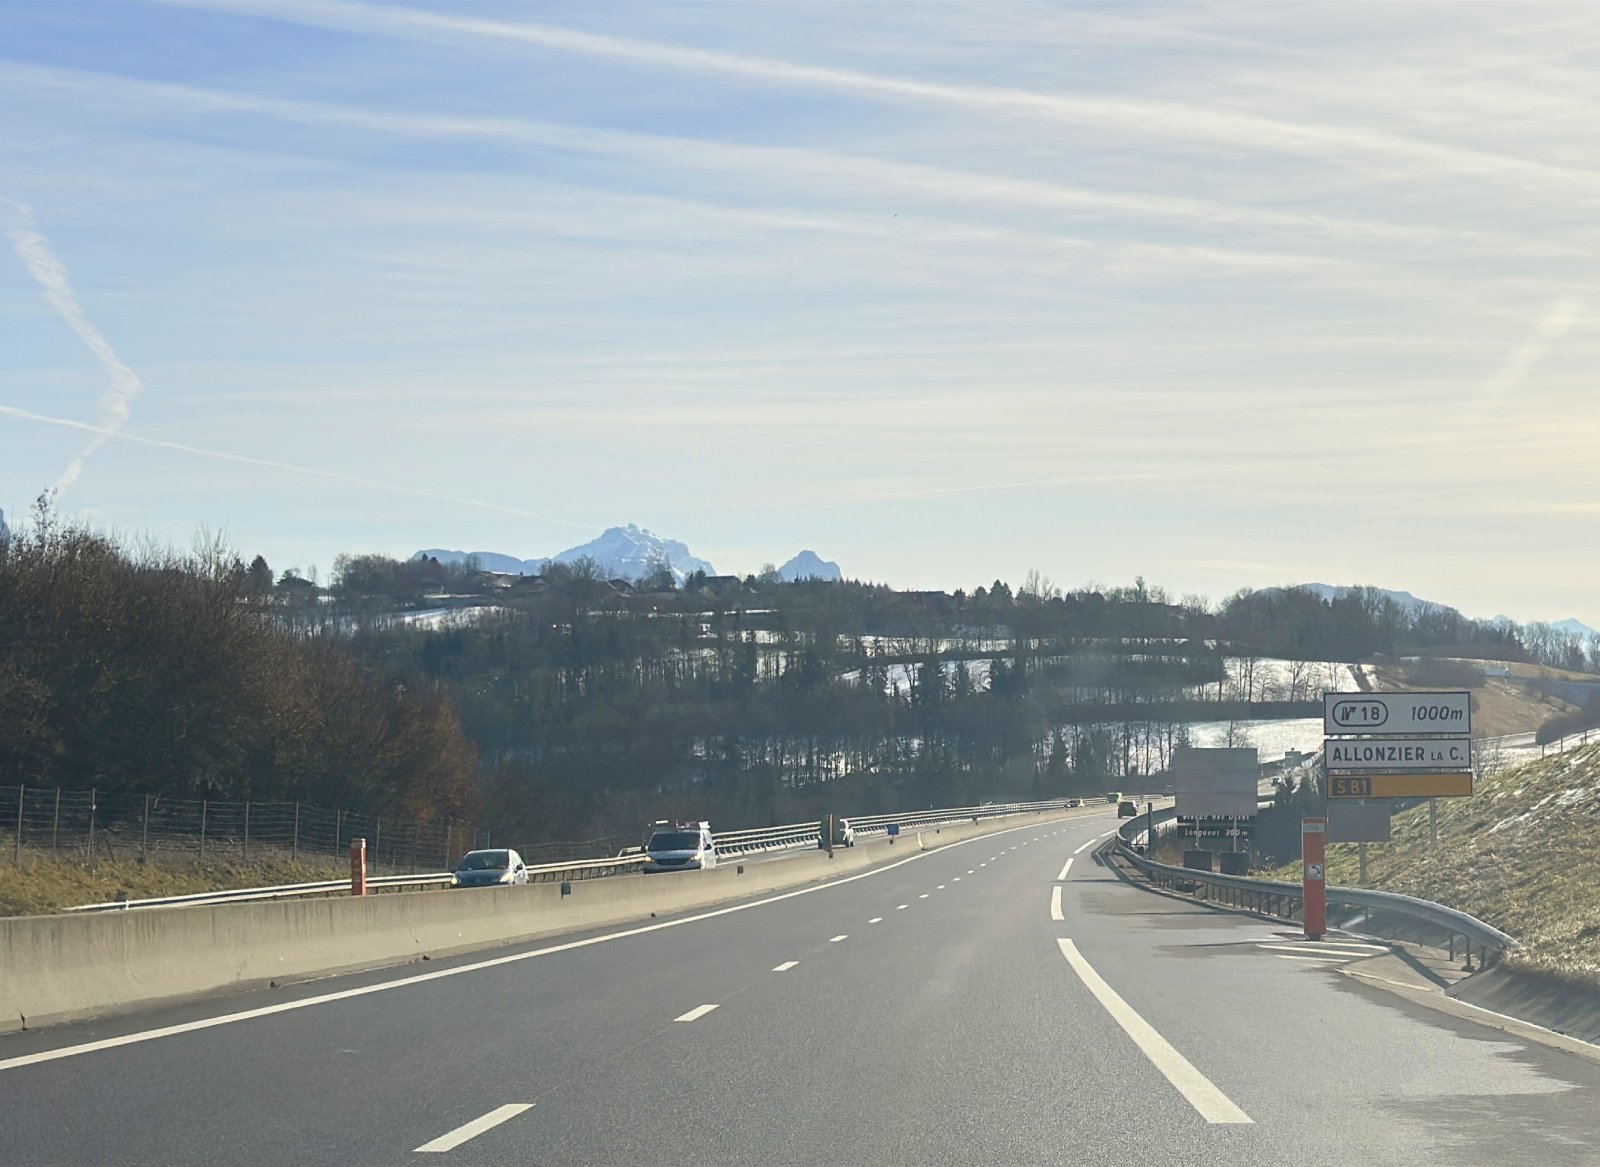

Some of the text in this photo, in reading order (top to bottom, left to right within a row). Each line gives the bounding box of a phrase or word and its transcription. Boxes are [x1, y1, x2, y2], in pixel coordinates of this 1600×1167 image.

[1361, 706, 1463, 720] 18 1000m
[1332, 747, 1463, 761] ALLONZIER LA C.
